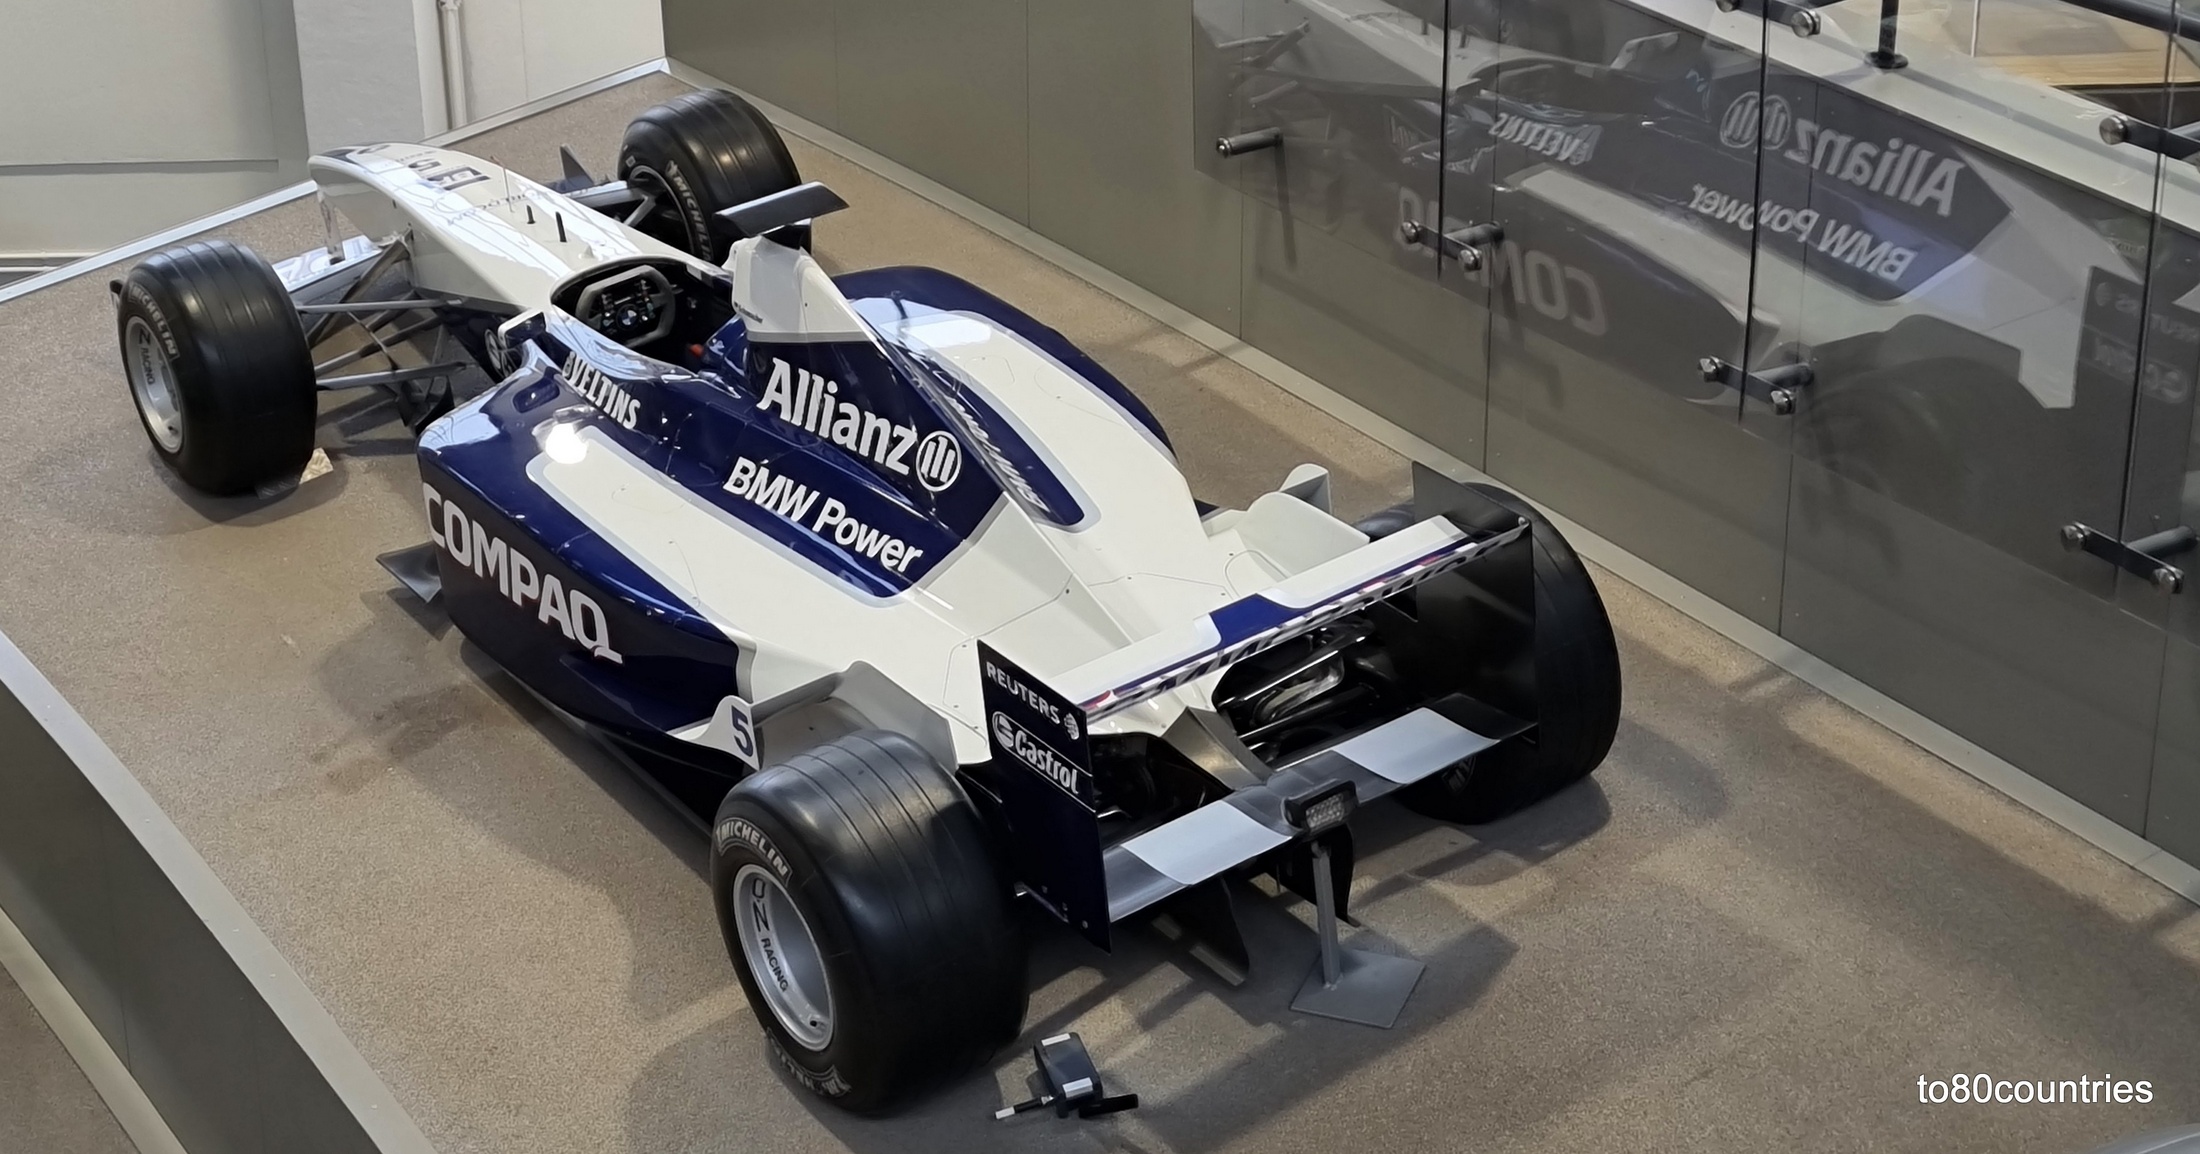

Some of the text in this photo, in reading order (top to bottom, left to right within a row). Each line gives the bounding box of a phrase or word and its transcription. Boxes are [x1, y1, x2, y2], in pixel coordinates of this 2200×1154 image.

[757, 357, 917, 475] Allianz
[723, 457, 923, 574] BMW Power
[422, 482, 624, 665] COMPAQ
[986, 661, 1061, 725] REUTERS
[731, 705, 754, 758] 5
[1015, 730, 1079, 795] Castrol
[718, 820, 788, 878] MICHELIN
[761, 937, 788, 993] RACING
